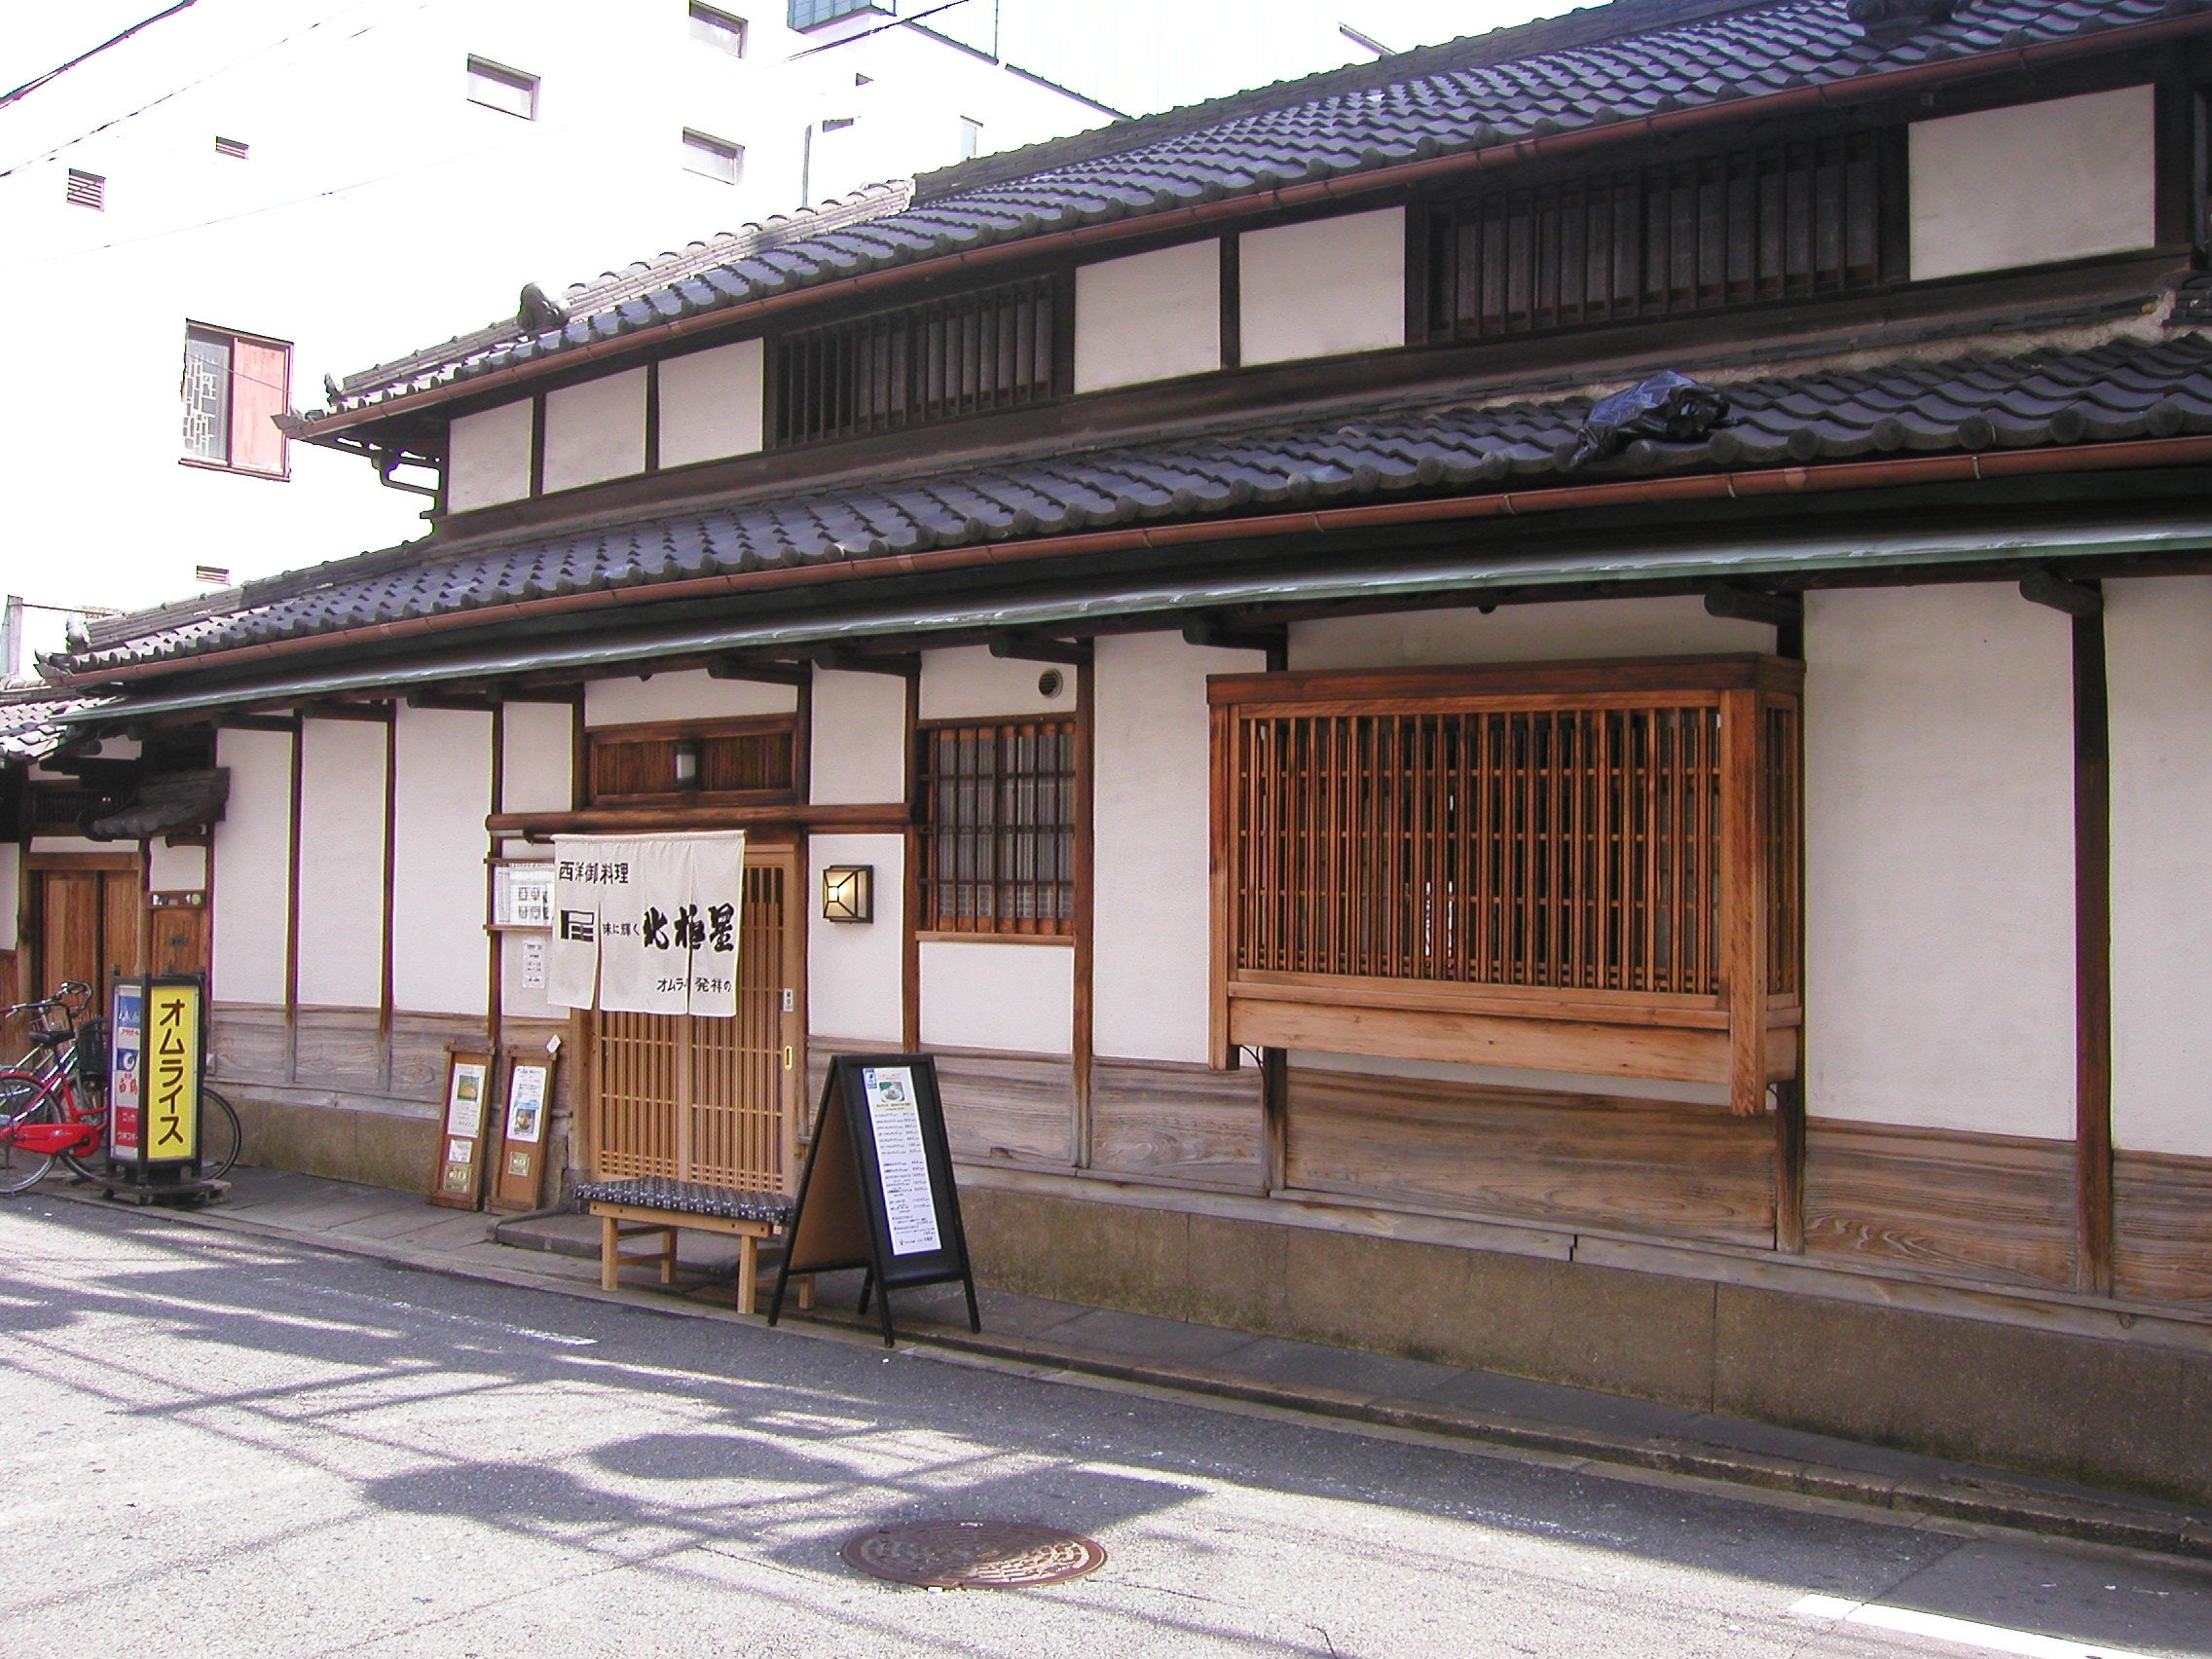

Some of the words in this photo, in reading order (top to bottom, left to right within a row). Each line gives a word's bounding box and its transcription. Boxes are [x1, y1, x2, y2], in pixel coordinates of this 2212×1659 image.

[559, 861, 629, 884] 西洋御料理
[602, 921, 641, 937] 味に輝く
[643, 903, 735, 952] 北極星
[159, 998, 186, 1146] オムライス
